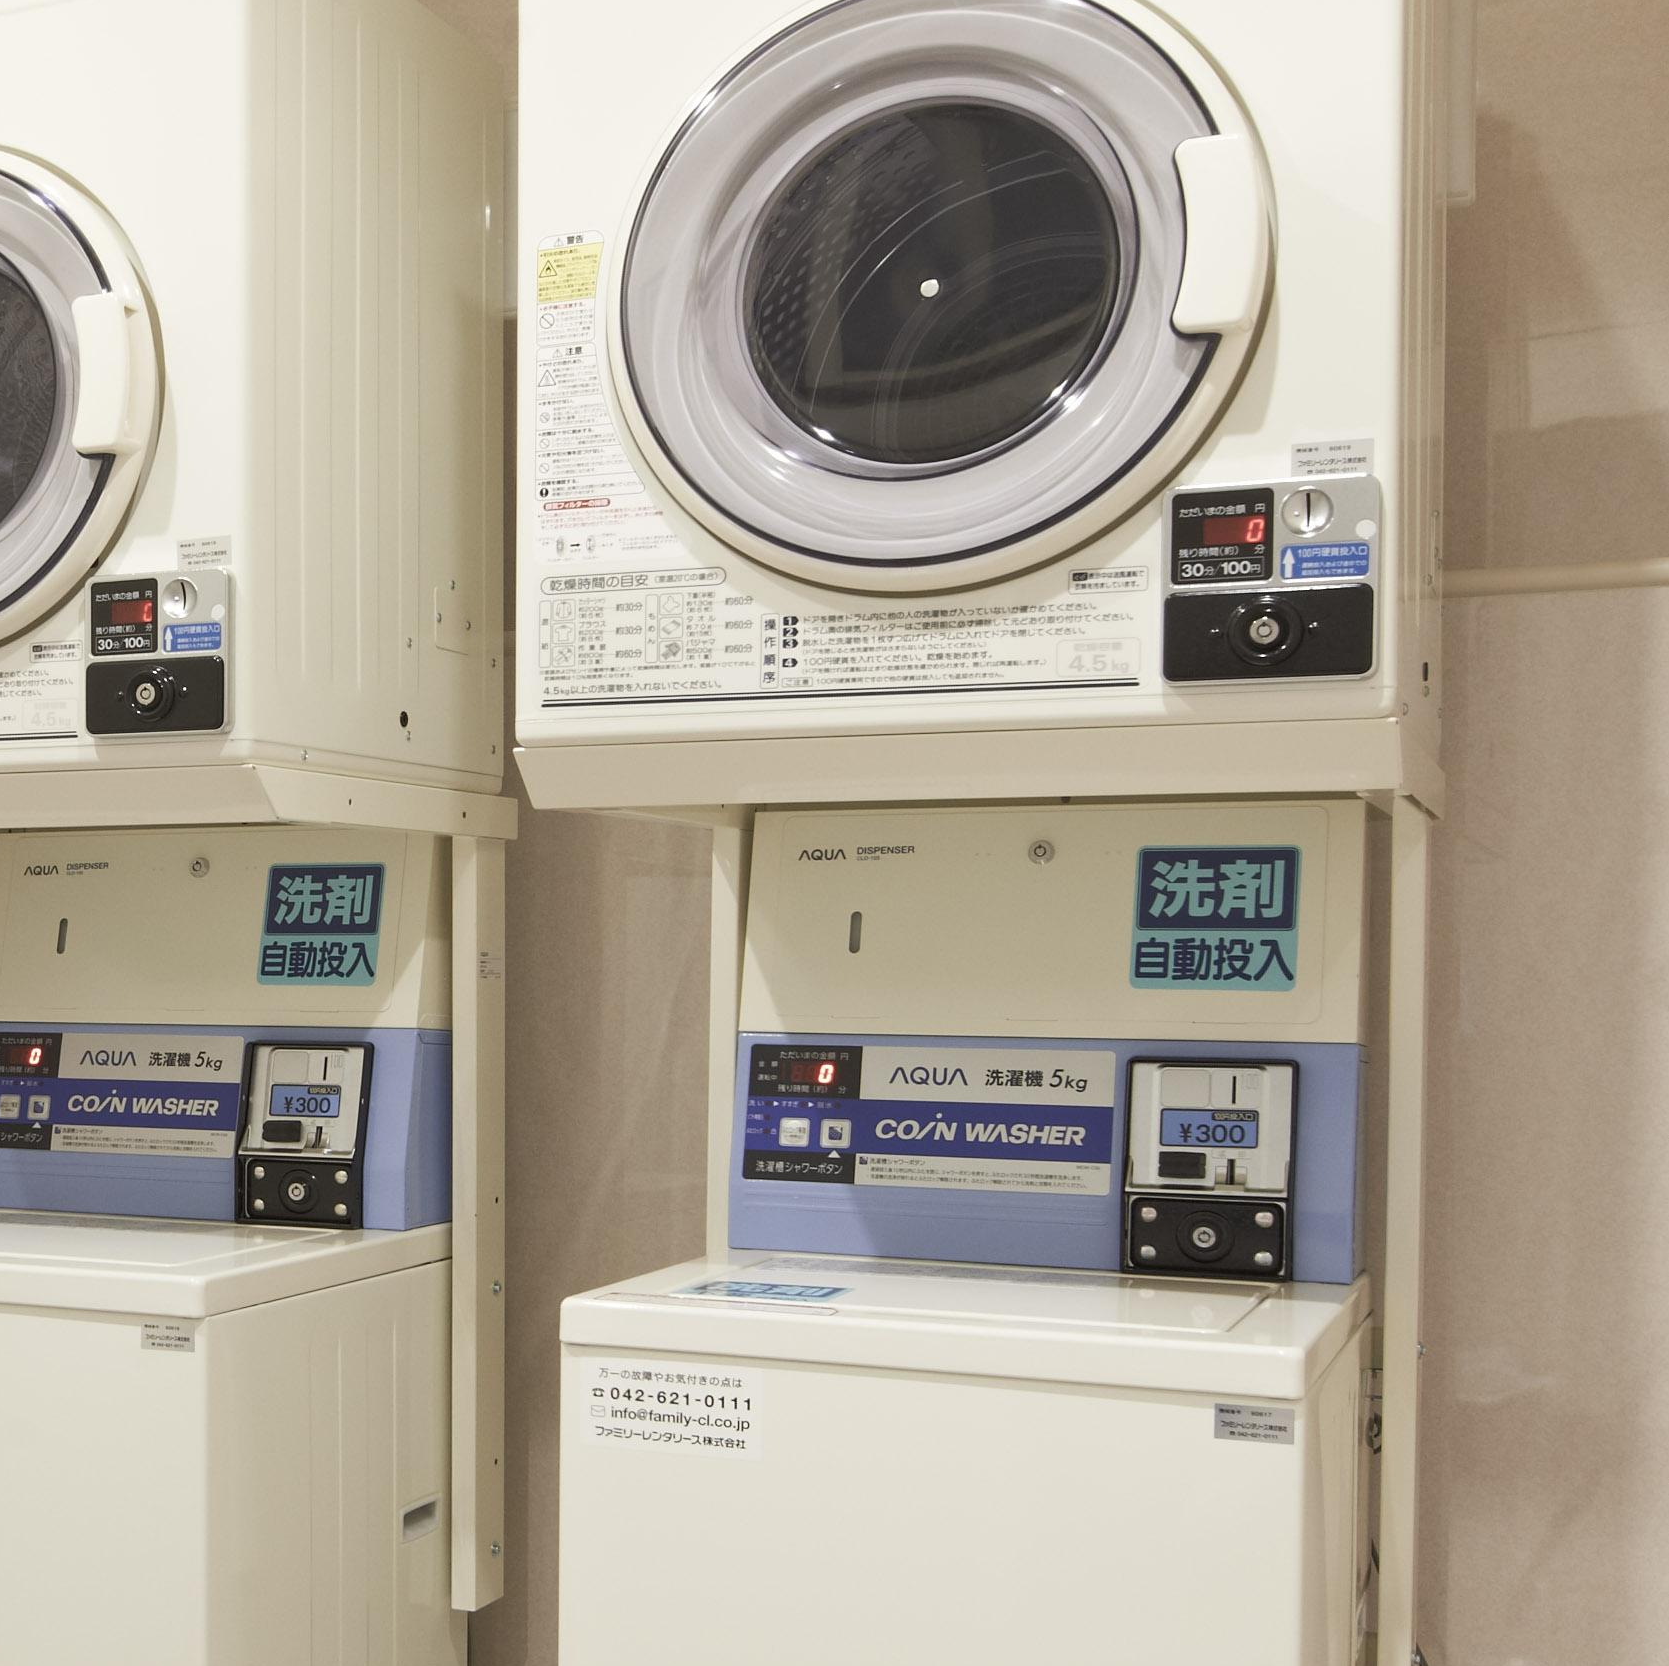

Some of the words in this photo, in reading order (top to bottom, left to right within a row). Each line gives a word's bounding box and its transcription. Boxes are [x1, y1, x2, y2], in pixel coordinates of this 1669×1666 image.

[565, 347, 582, 355] 注意
[1179, 505, 1246, 517] ただいまの金額
[1255, 503, 1265, 512] 円
[1247, 519, 1265, 542] 0
[1255, 545, 1265, 554] 分
[1298, 547, 1367, 558] 100円硬貨投入口
[550, 574, 648, 592] 乾燥時間の目安
[146, 623, 152, 631] 分
[764, 619, 776, 684] 操作順序
[1069, 654, 1107, 672] 4.5
[1112, 660, 1130, 673] kg
[798, 849, 846, 861] AQUA
[857, 846, 915, 855] DISPENSER
[24, 865, 59, 876] AQUA
[66, 862, 109, 871] DISPENSER
[1149, 859, 1284, 919] 洗剤
[274, 874, 373, 926] 洗剤
[262, 940, 374, 979] 自動投入
[1134, 937, 1294, 982] 自動投入
[29, 1048, 41, 1064] 0
[80, 1050, 137, 1067] AQUA
[149, 1051, 190, 1067] 洗濯機
[194, 1051, 223, 1071] 5kg
[818, 1064, 834, 1083] 0
[889, 1066, 969, 1087] AQUA
[985, 1068, 1044, 1089] 洗濯機
[1049, 1068, 1089, 1093] 5kg
[132, 1096, 219, 1117] WASHER
[284, 1097, 331, 1113] ¥300
[964, 1122, 1086, 1148] WASHER
[1180, 1123, 1245, 1143] ¥300
[756, 1160, 843, 1174] 洗濯槽シャワーボタン
[599, 1368, 742, 1387] 万一の故障やお気付きの点は
[611, 1388, 751, 1411] 042-621-0111
[611, 1407, 750, 1432] info@family-cl.co.jp
[595, 1426, 746, 1449] ファミリーレンタリース株式会社
